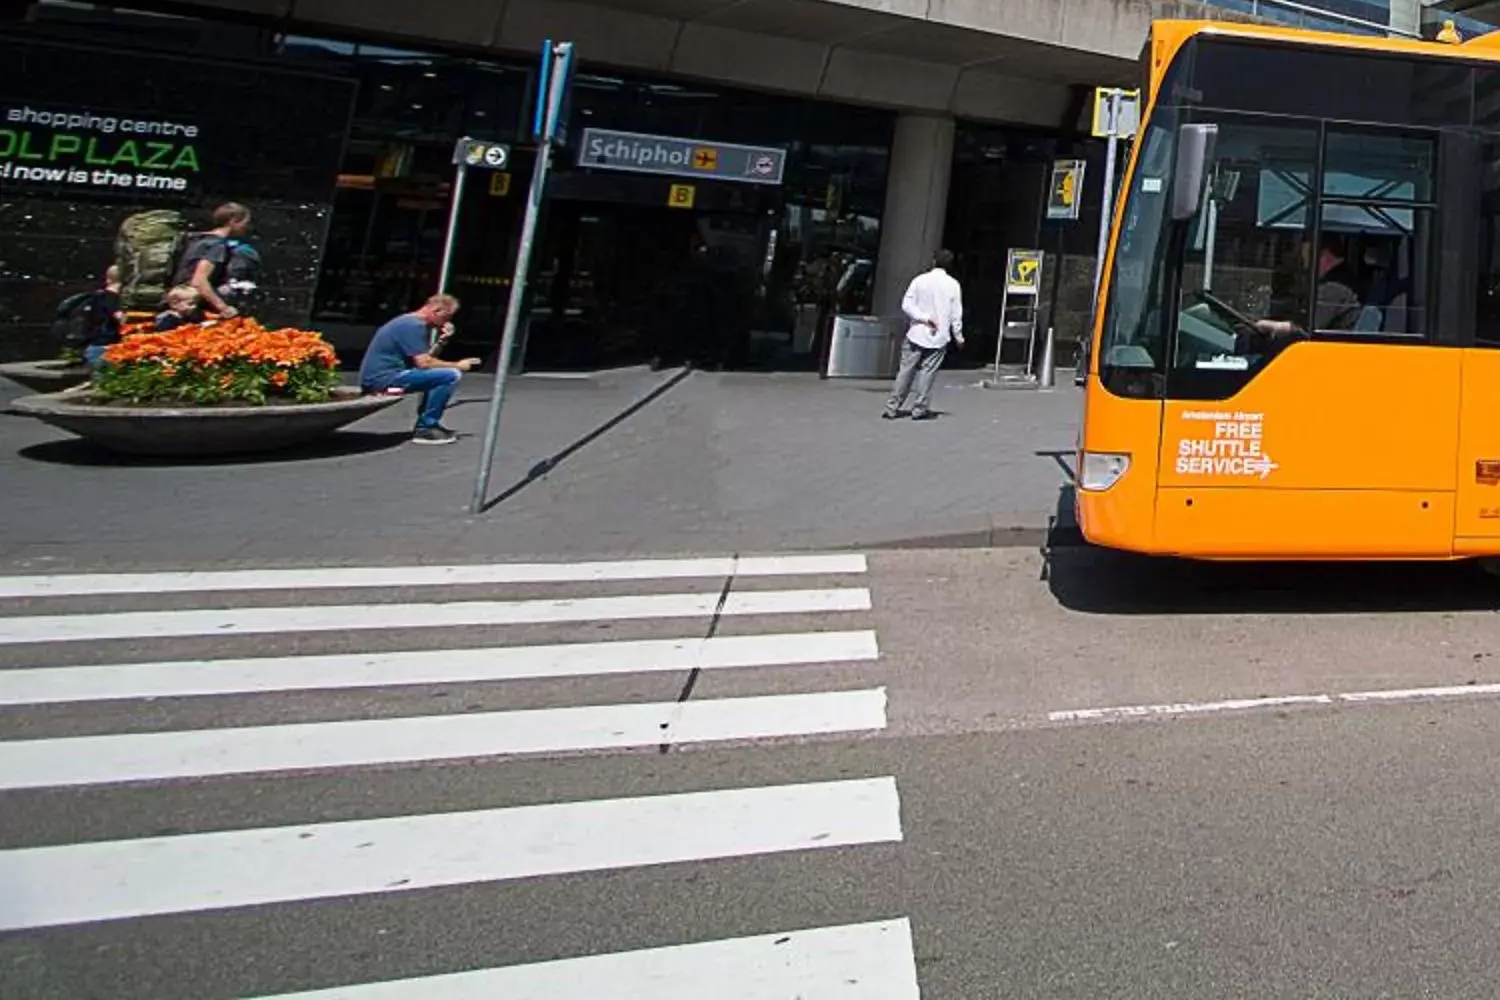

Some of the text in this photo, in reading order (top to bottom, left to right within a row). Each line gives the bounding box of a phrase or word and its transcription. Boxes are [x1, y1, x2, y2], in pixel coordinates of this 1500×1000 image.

[7, 106, 199, 137] shopping centre
[49, 134, 200, 171] PLAZA
[589, 138, 692, 166] Schiphol
[13, 165, 67, 182] now
[67, 166, 88, 183] is
[92, 169, 133, 187] the
[135, 172, 187, 191] time
[1215, 421, 1263, 439] FREE
[1178, 439, 1261, 457] SHUTTLE
[1175, 457, 1256, 475] SERVICE
